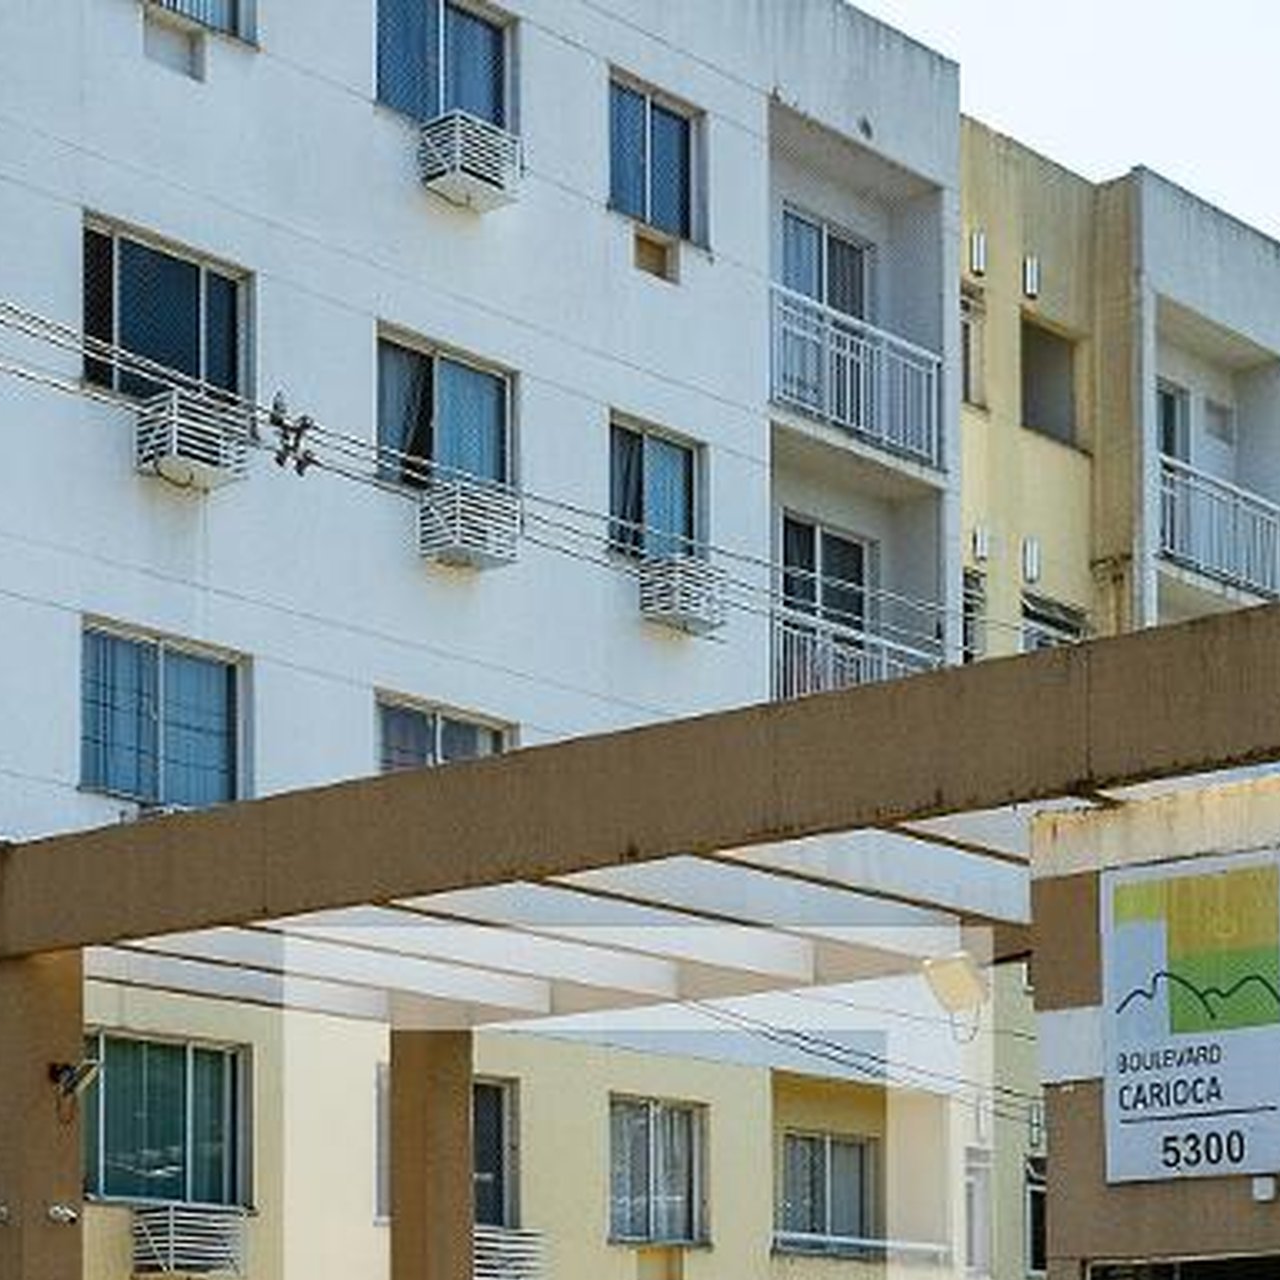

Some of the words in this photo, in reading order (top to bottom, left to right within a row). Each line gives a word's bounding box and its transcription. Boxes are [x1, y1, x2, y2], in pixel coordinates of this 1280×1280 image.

[1118, 1044, 1222, 1074] BOULEVARD
[1119, 1076, 1223, 1111] CARIOCA
[1161, 1130, 1246, 1168] 5300
